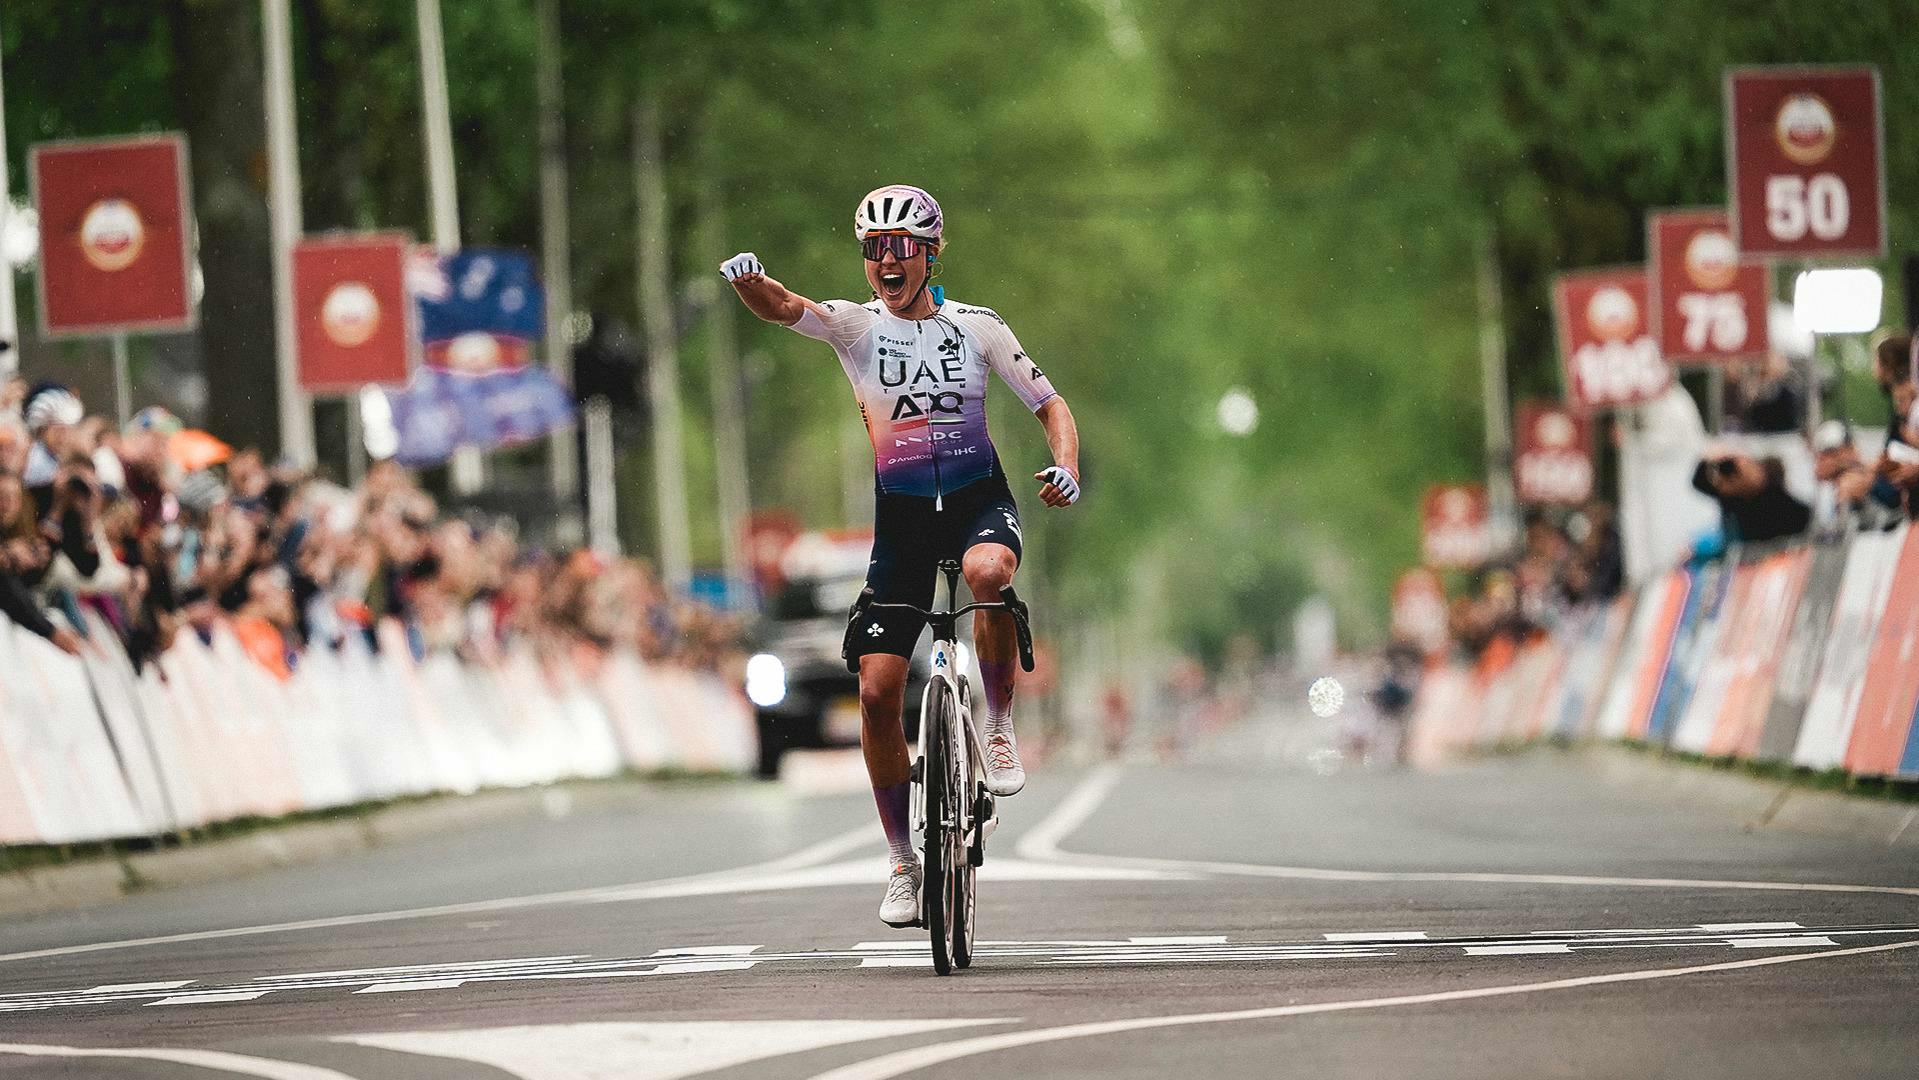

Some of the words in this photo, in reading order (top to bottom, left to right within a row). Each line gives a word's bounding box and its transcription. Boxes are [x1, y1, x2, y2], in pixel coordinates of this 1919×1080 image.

[1764, 172, 1849, 241] 50
[1676, 291, 1748, 351] 75
[879, 358, 966, 387] UAE
[883, 383, 966, 394] TEAM
[953, 445, 977, 456] IHC
